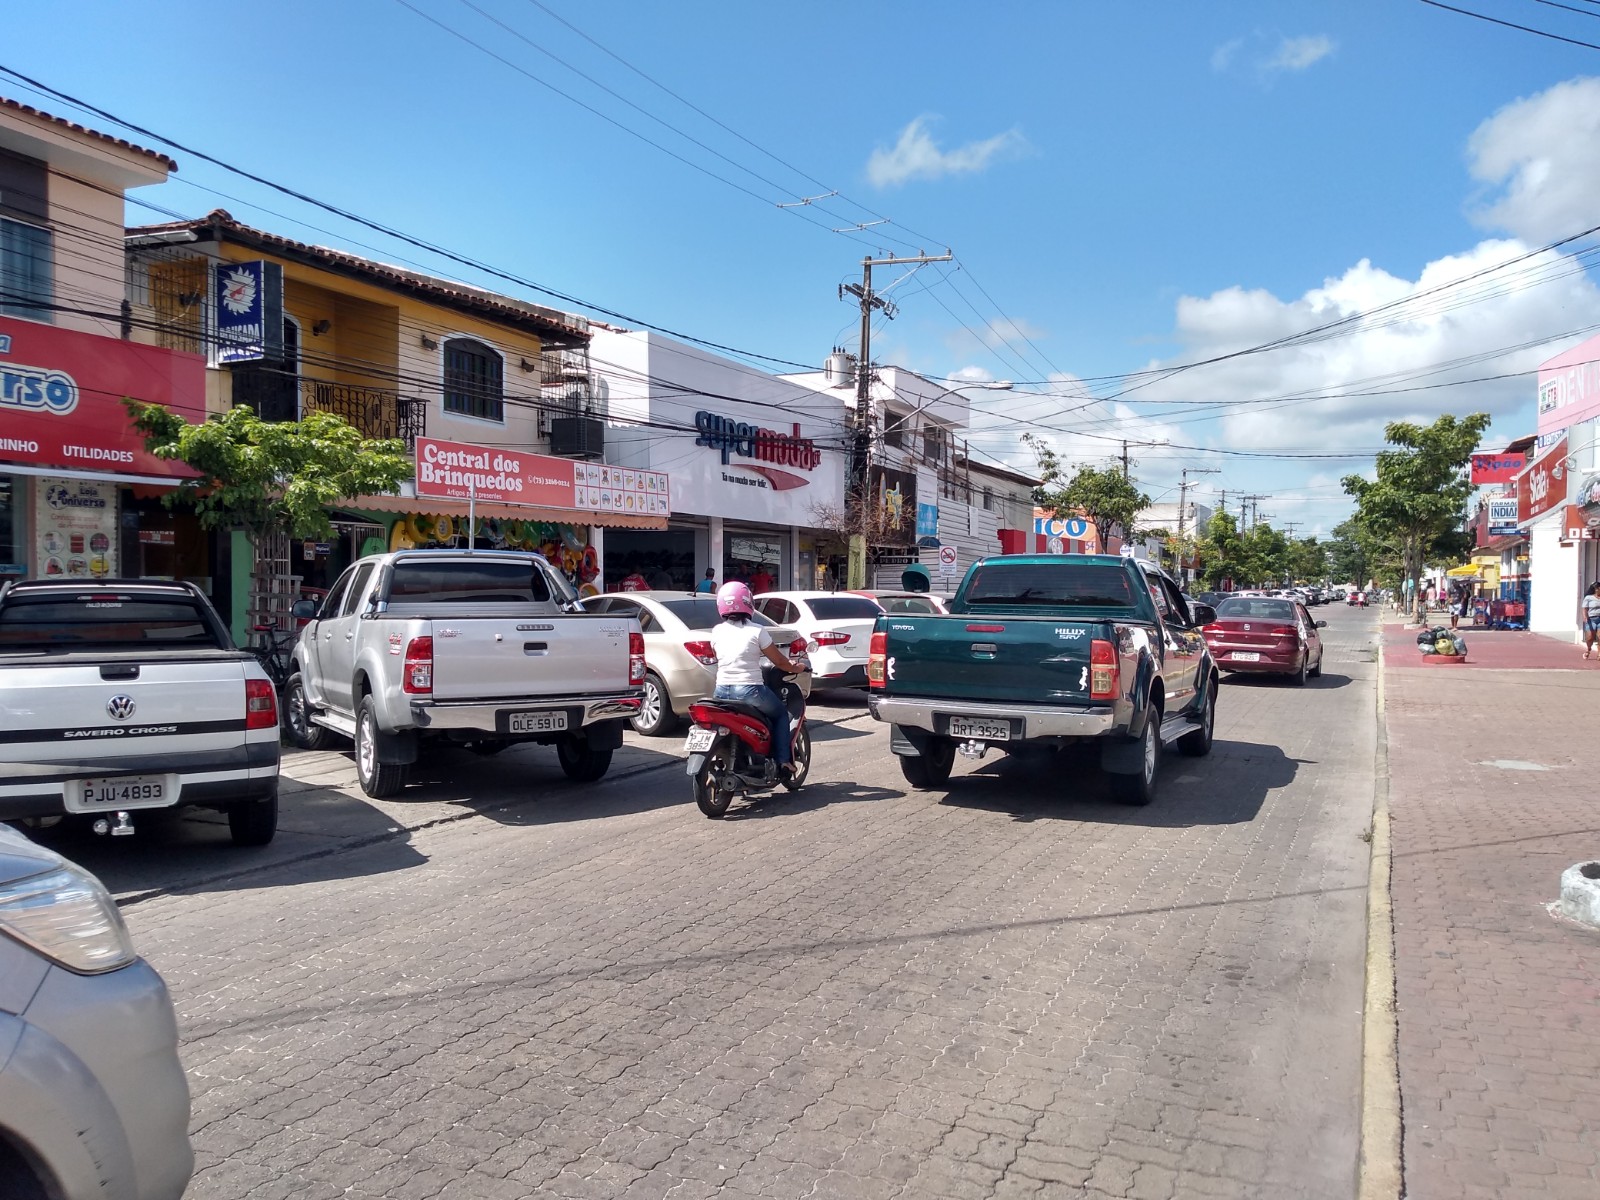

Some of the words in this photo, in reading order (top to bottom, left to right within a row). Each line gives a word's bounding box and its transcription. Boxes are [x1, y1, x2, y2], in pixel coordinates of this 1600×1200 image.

[63, 445, 134, 462] UTILIDADES
[424, 444, 489, 470] Central
[493, 454, 520, 474] dos
[420, 462, 523, 493] Brinquedos
[447, 488, 465, 497] Artigos
[1055, 628, 1086, 636] HILUX
[63, 728, 125, 739] SAVEIRO
[128, 725, 178, 735] CROSS
[686, 742, 709, 750] 3852
